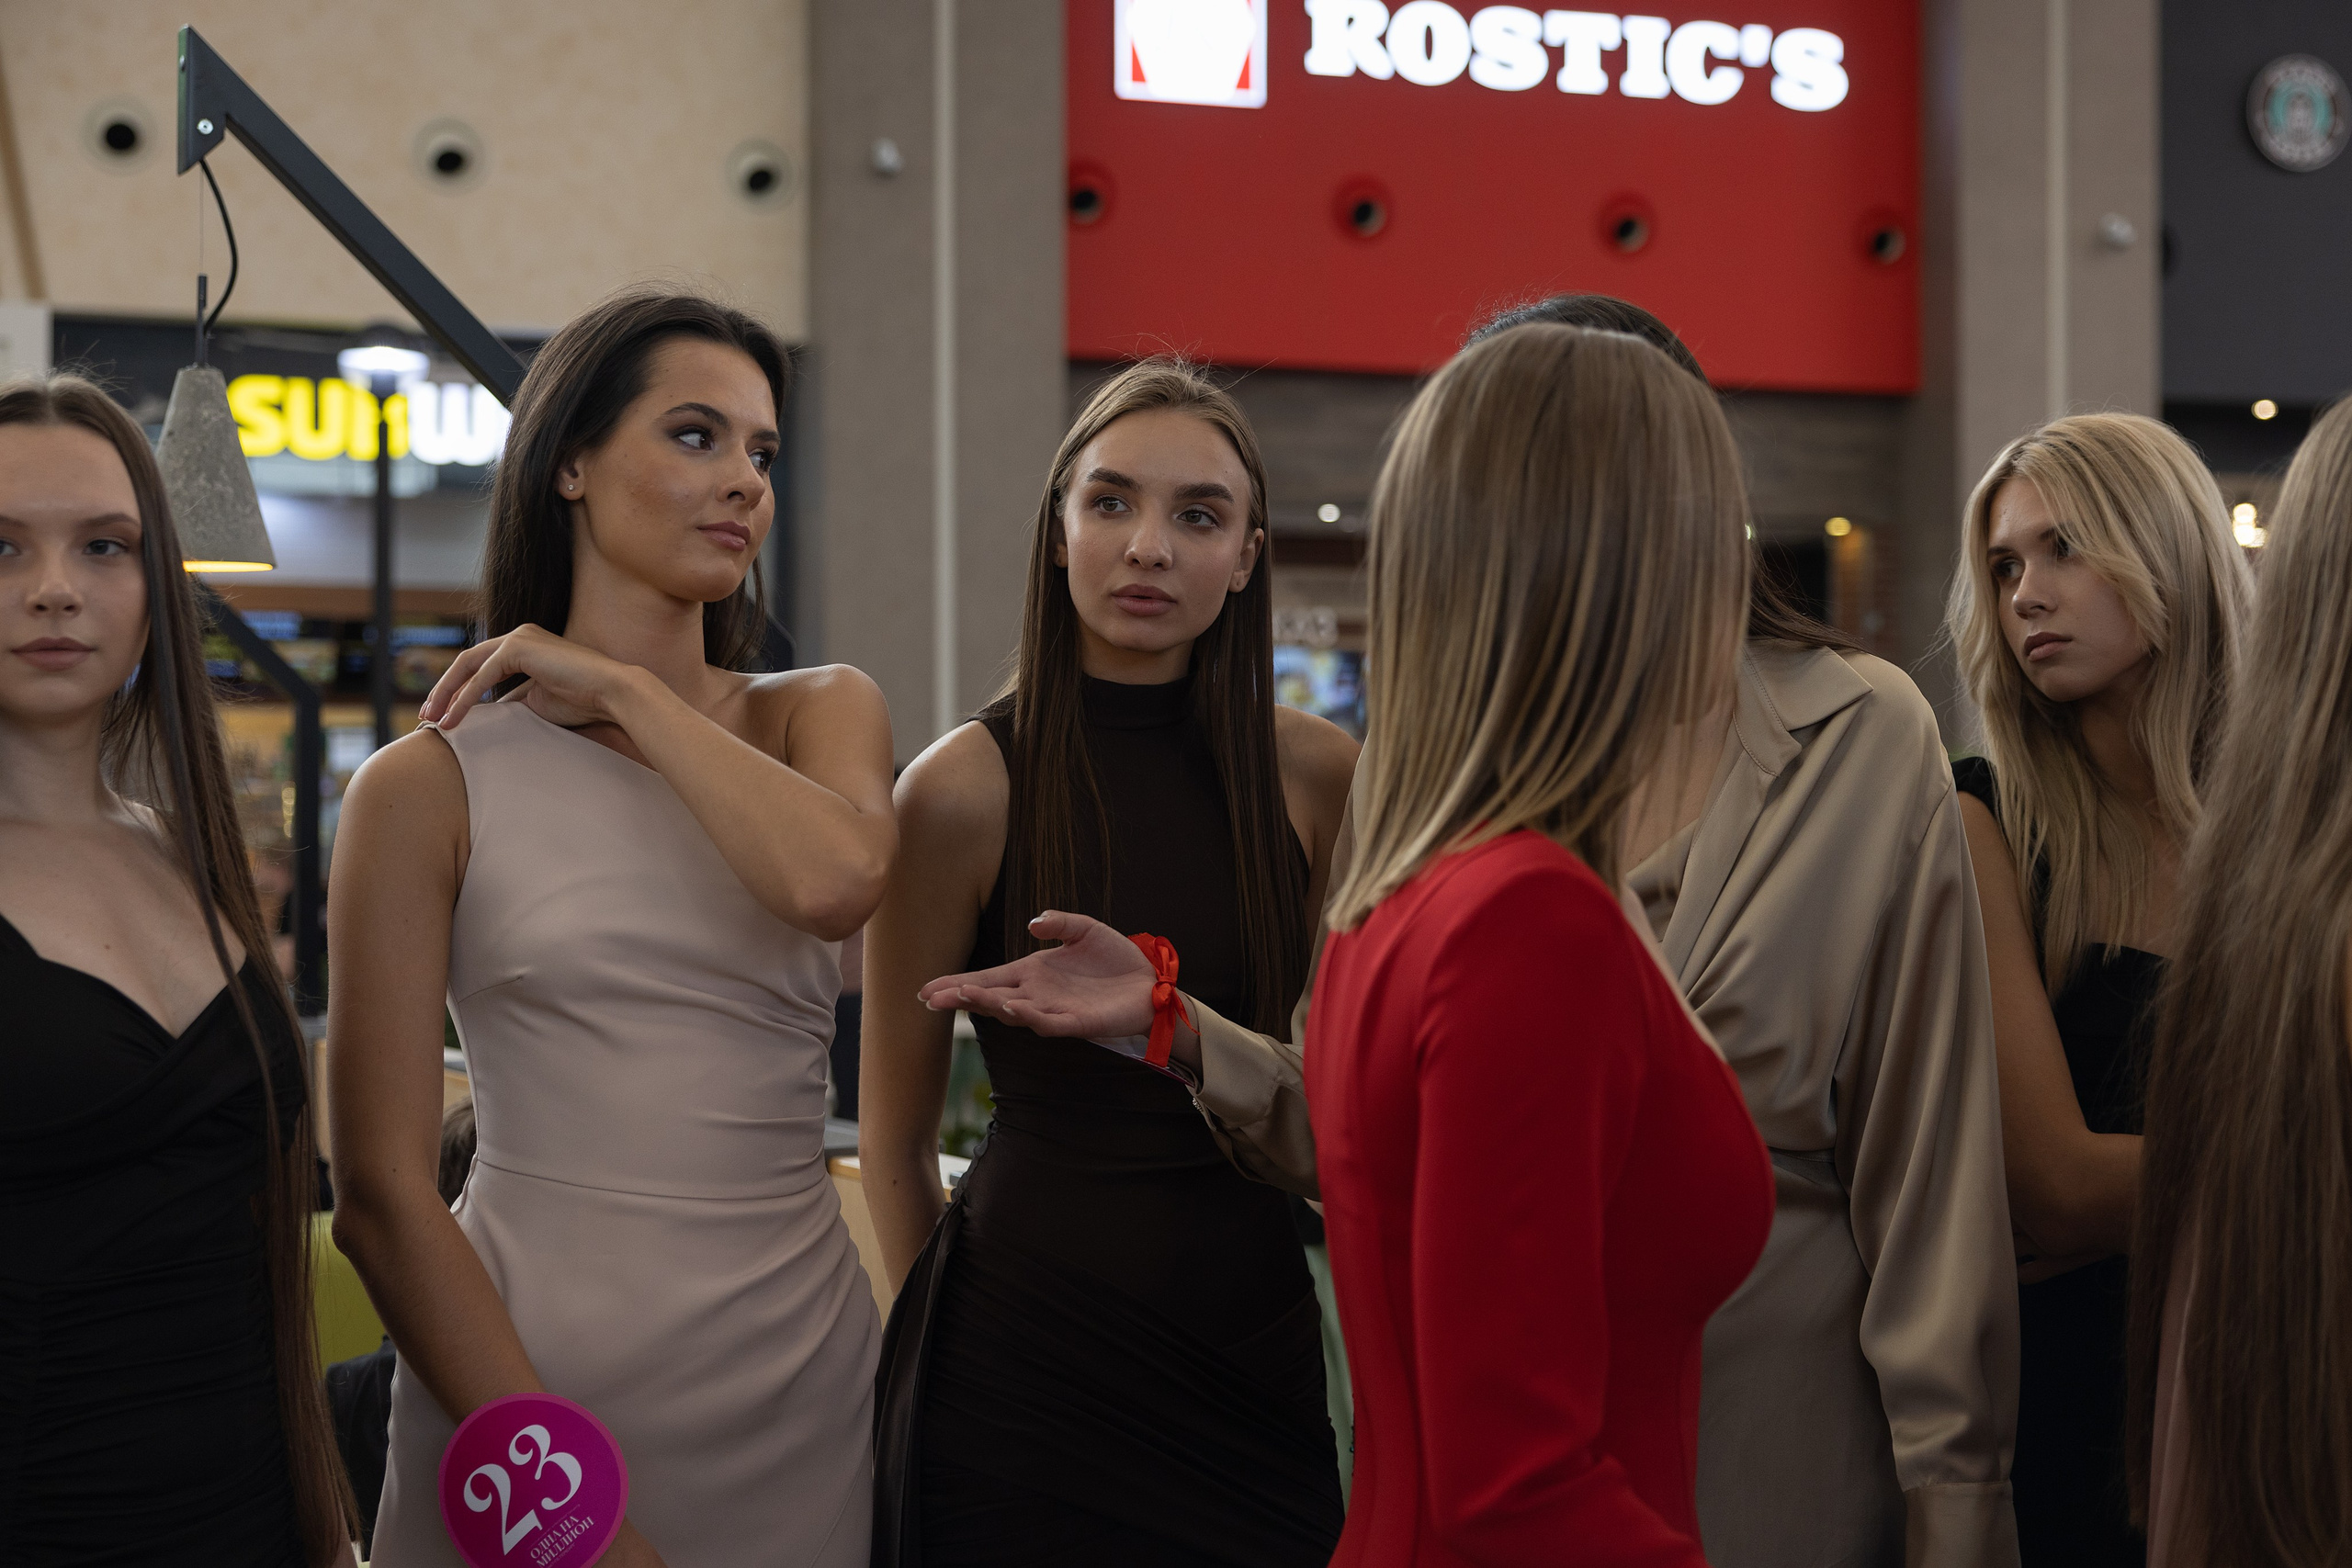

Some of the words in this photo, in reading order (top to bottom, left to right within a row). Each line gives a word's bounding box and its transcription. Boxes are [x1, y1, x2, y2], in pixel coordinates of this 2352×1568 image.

[1304, 0, 1849, 112] ROSTIC'S
[464, 1425, 582, 1555] 23
[530, 1530, 561, 1559] ОДНА
[560, 1516, 579, 1532] НА
[537, 1517, 594, 1567] МИЛЛИОН
